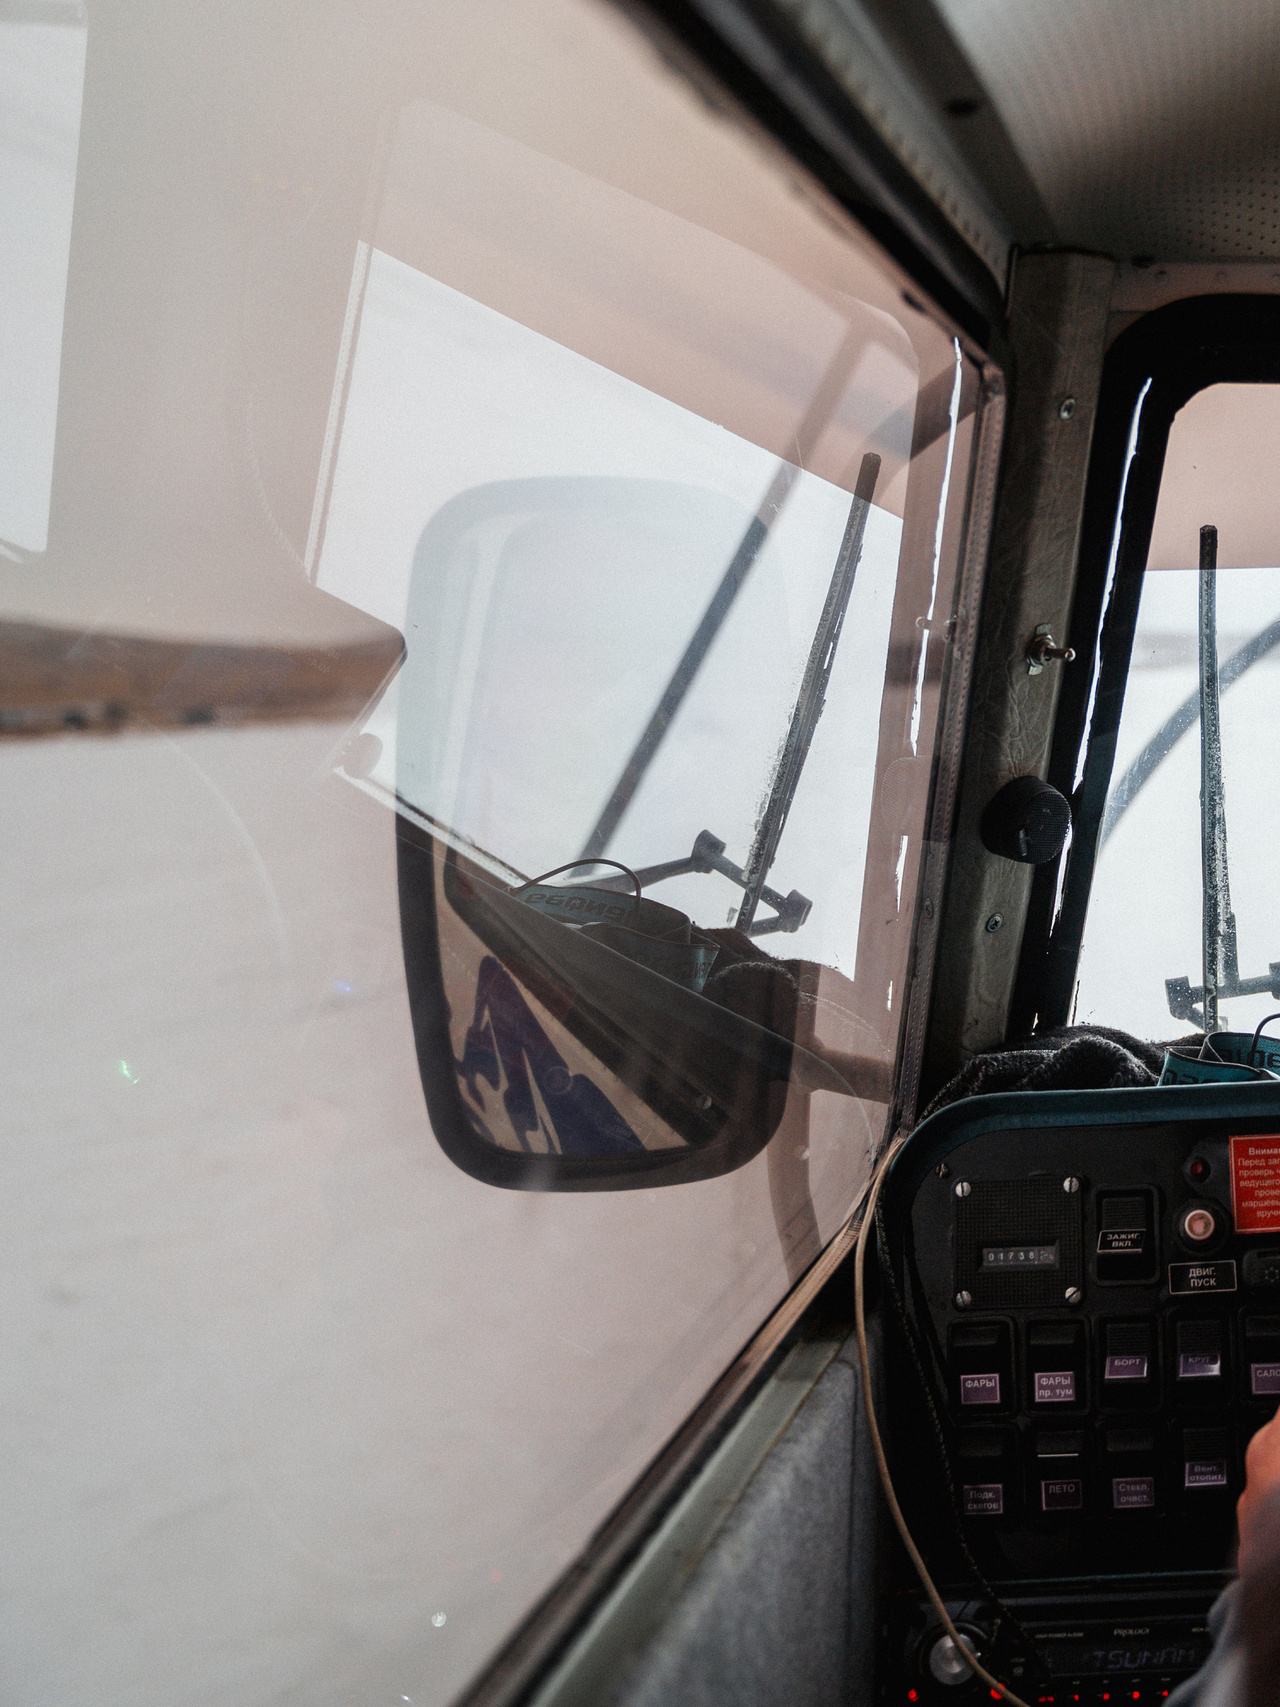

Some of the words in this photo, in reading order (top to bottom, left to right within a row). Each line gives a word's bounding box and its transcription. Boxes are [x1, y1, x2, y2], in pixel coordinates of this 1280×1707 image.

[1237, 1158, 1266, 1167] Перед
[1238, 1169, 1275, 1178] проверь
[1239, 1178, 1280, 1188] ведущего
[1188, 1266, 1217, 1278] ДВИГ.
[1190, 1277, 1217, 1288] ПУСК
[1113, 1357, 1141, 1367] БОРТ
[965, 1378, 995, 1389] ФАРЫ
[1039, 1375, 1071, 1387] ФАРЫ
[1048, 1483, 1075, 1494] ЛЕТО
[1113, 1627, 1150, 1638] PROLOGY
